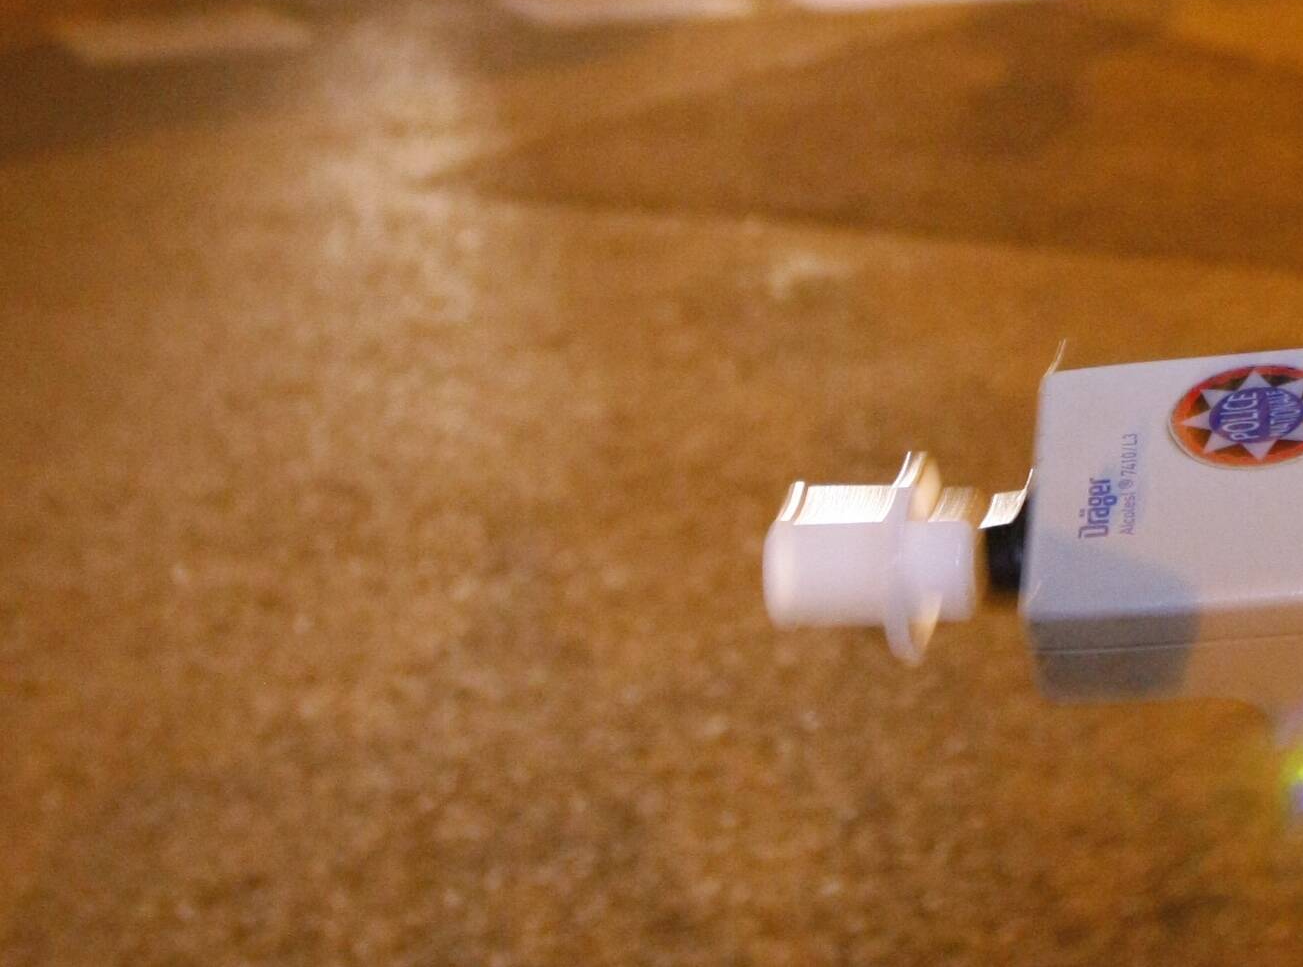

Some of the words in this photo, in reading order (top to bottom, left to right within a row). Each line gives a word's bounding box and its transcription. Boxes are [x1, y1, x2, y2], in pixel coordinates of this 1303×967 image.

[1219, 391, 1261, 441] POLICE
[1120, 432, 1138, 477] 7410/L3
[1078, 477, 1118, 539] Dräger
